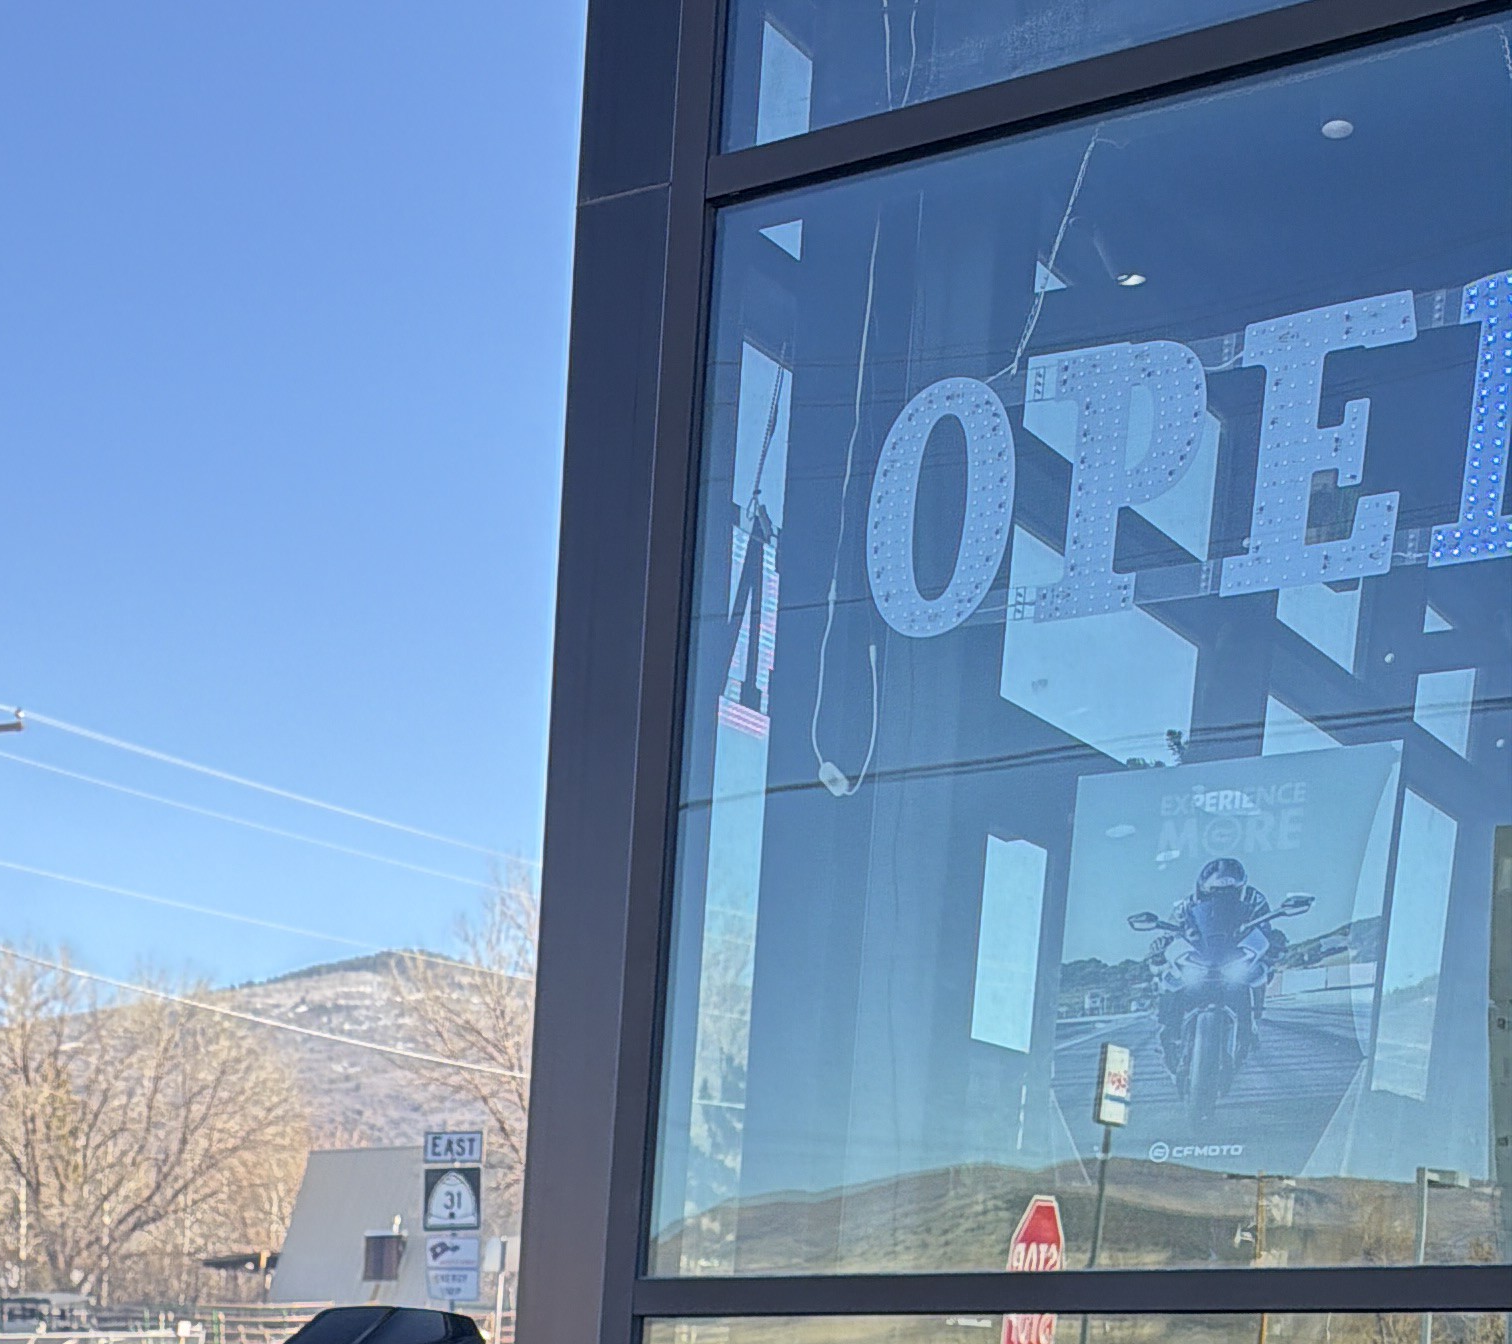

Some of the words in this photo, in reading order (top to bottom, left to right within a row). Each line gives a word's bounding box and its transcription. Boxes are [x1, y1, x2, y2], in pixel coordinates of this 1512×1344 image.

[1160, 781, 1307, 817] EXPERIENCE
[431, 1135, 476, 1157] EAST
[1171, 1144, 1243, 1158] CFMOTO
[443, 1190, 462, 1210] 31
